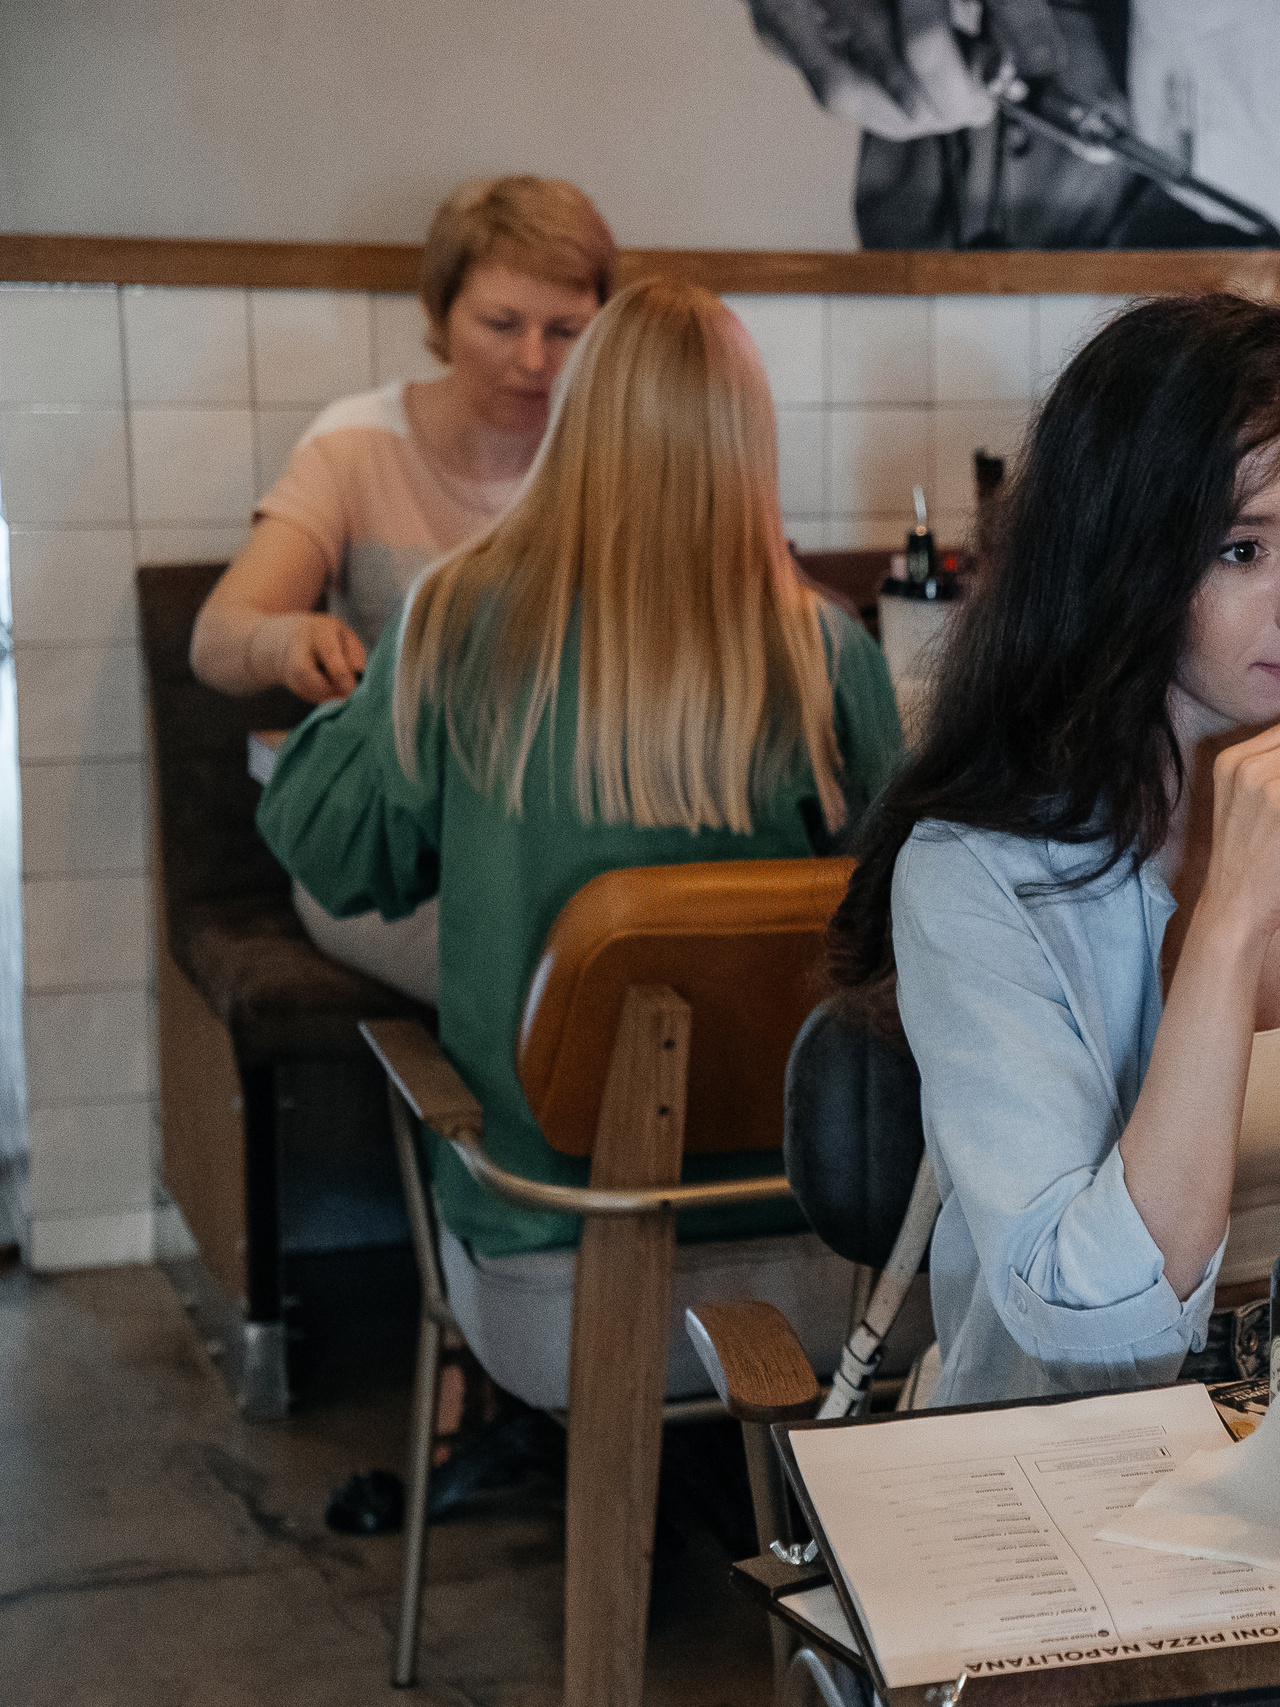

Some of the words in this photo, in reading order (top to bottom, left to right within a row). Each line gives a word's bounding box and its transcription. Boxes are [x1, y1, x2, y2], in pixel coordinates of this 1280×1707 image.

[1231, 1611, 1276, 1621] Маргарита
[1146, 1633, 1226, 1651] PIZZA
[965, 1644, 1140, 1673] NAPOLITANA
